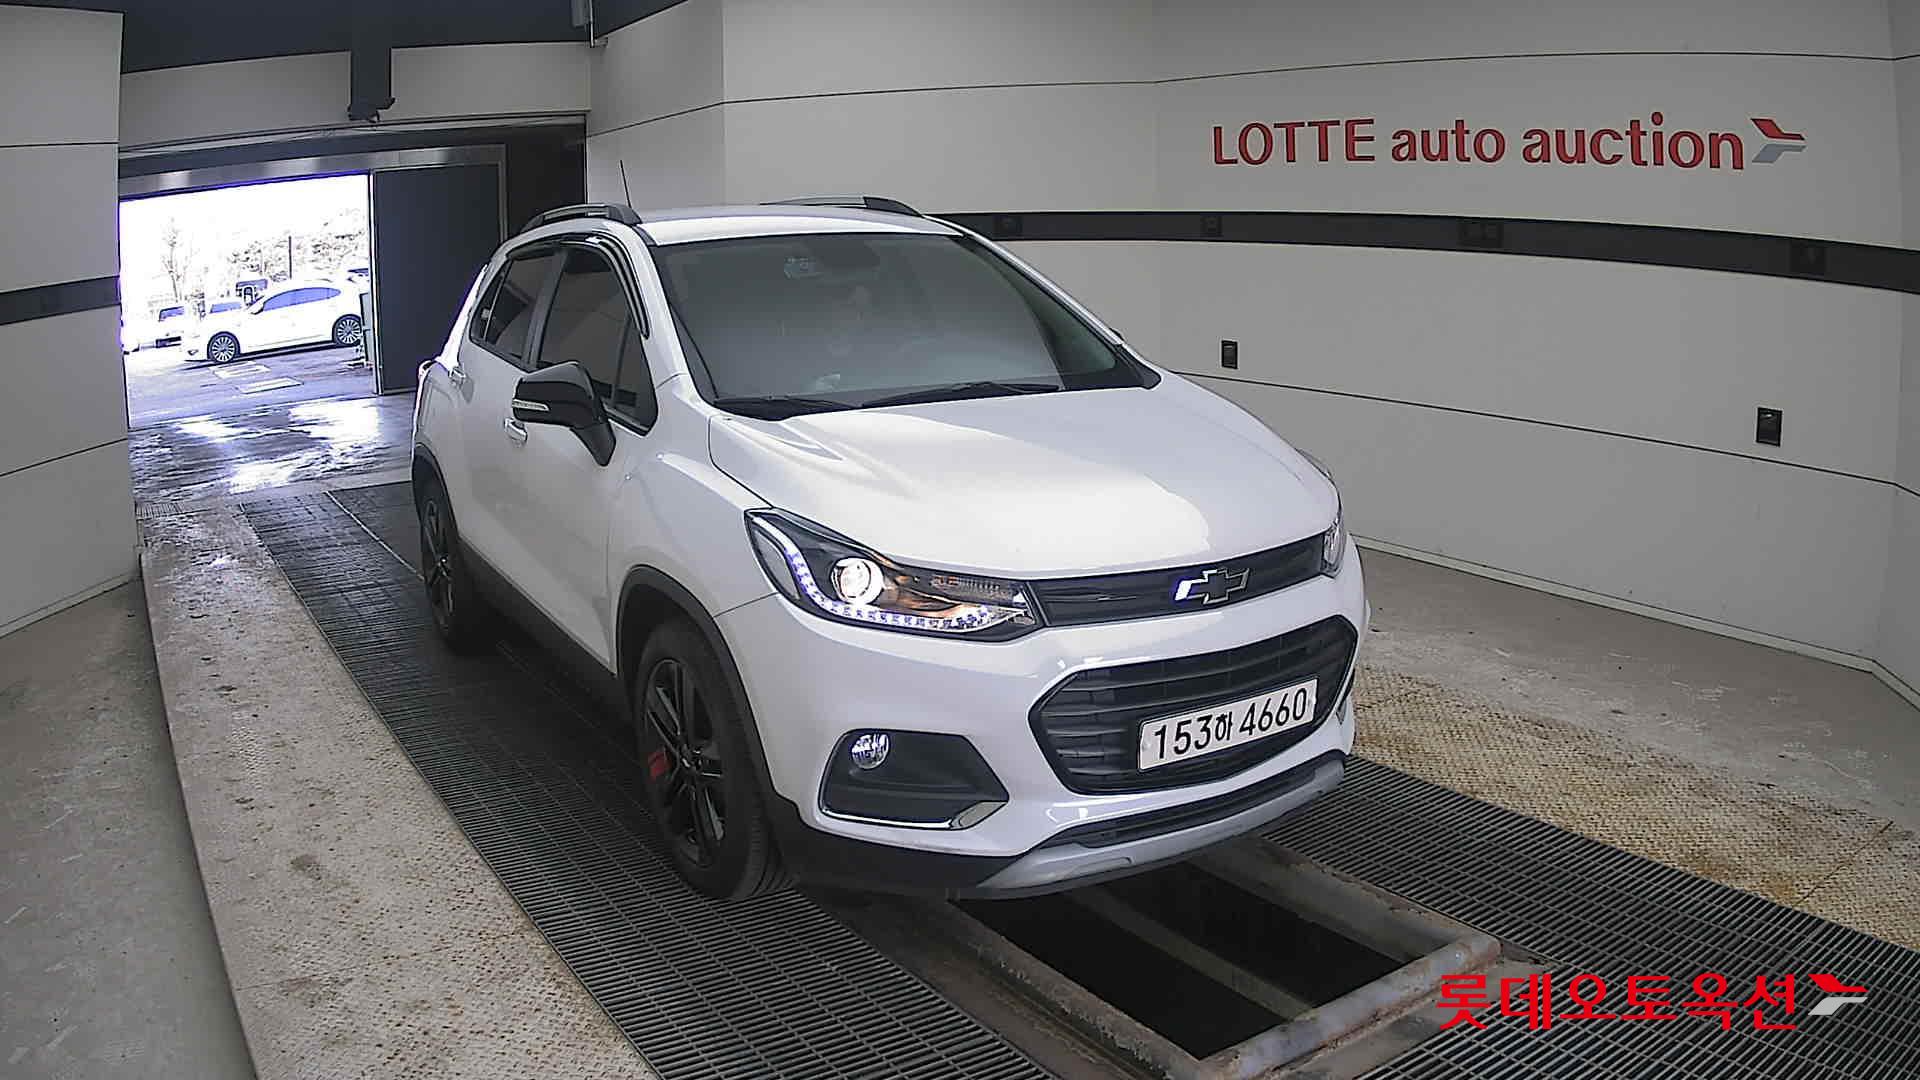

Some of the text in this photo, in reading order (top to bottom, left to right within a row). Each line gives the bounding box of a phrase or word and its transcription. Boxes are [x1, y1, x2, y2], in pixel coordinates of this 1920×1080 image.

[1212, 111, 1744, 170] LOTTE auto auction
[1154, 688, 1307, 759] 153하 4660
